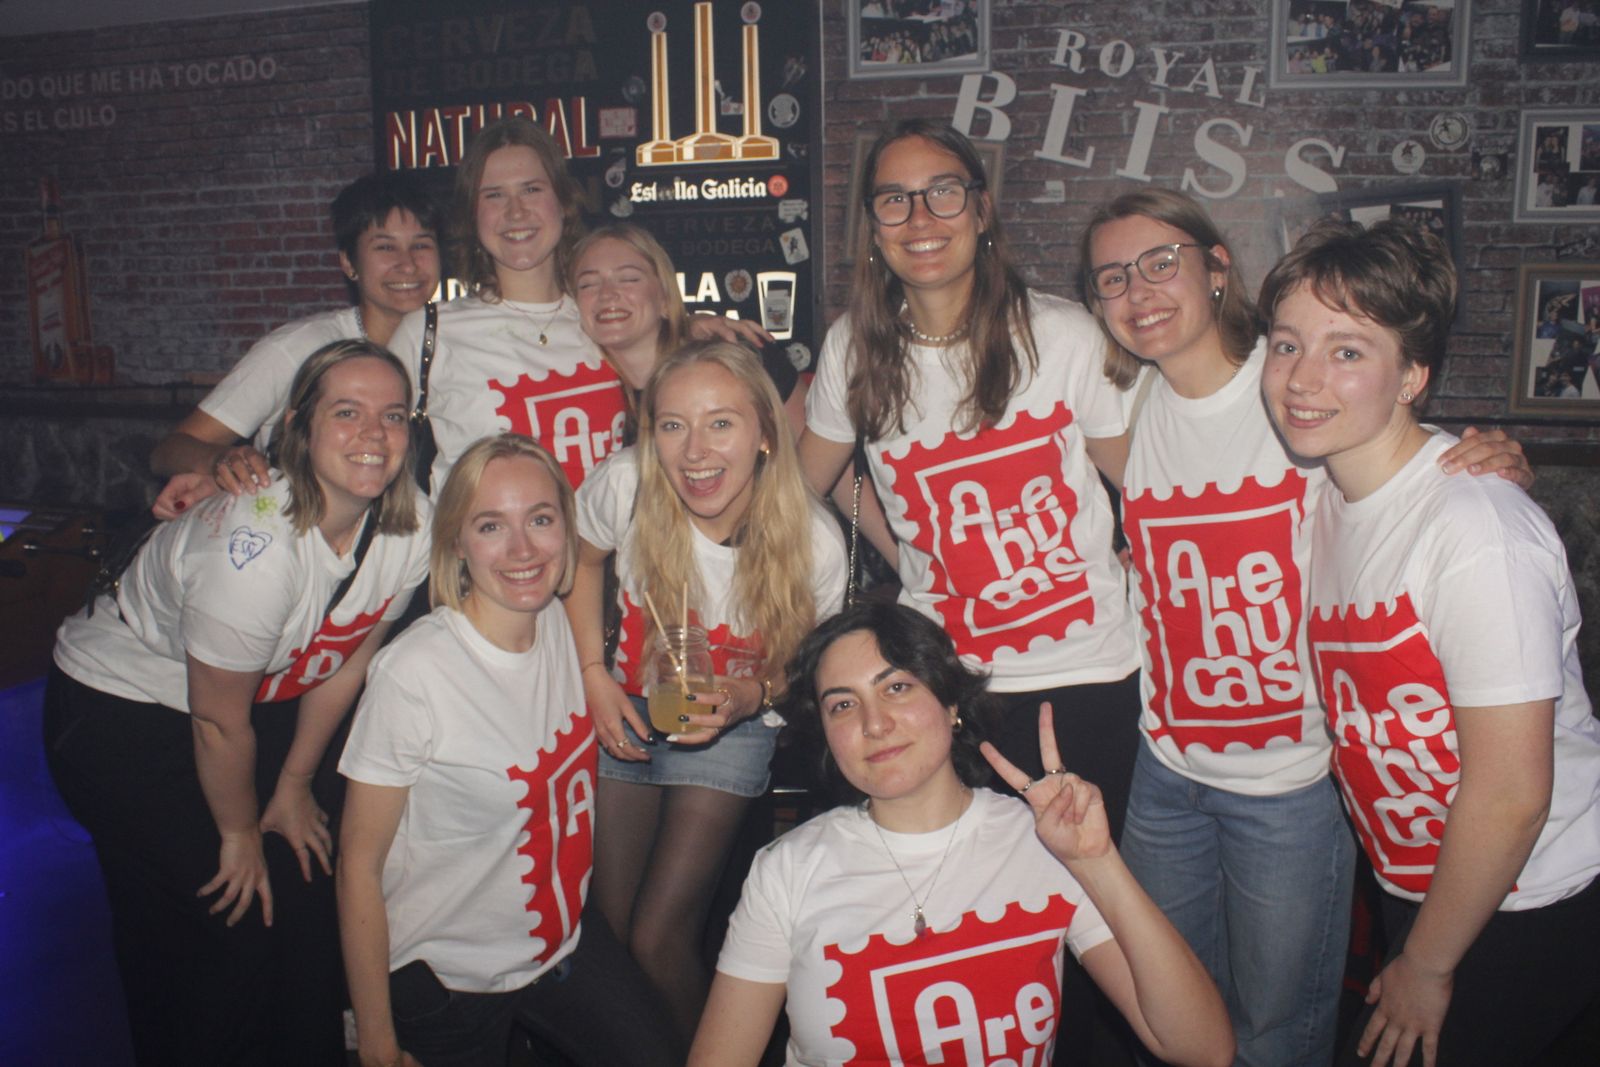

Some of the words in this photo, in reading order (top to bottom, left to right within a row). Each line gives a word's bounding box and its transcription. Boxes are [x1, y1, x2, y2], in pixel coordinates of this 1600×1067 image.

[383, 5, 598, 59] CERVEZA
[39, 73, 86, 98] QUE
[90, 70, 122, 93] ME
[128, 67, 164, 91] HA
[167, 56, 277, 88] TOCADO
[442, 49, 599, 92] BODEGA
[1049, 29, 1267, 109] ROYAL
[0, 111, 19, 132] S
[23, 110, 49, 131] EL
[53, 104, 117, 130] CULO
[950, 70, 1346, 199] BLISS
[629, 177, 698, 203] Estlla
[700, 176, 767, 200] Galicia
[949, 475, 1060, 545] Are
[1166, 539, 1284, 609] Are
[1182, 648, 1304, 708] cas
[1331, 667, 1451, 748] Are
[1372, 783, 1461, 849] ca
[913, 980, 1056, 1066] Are
